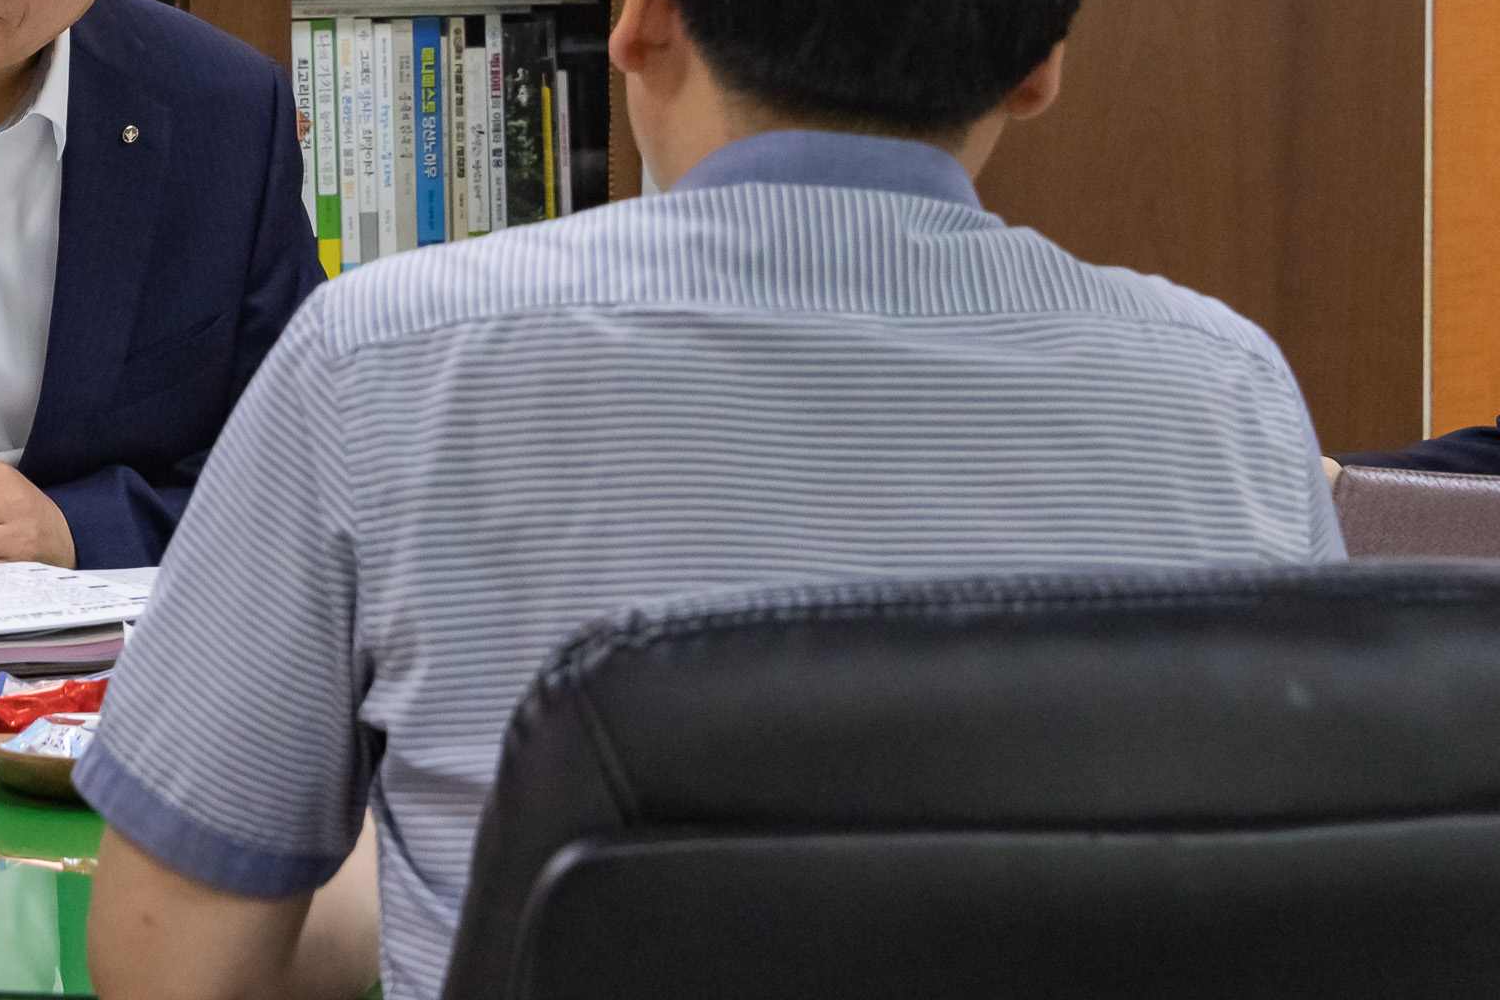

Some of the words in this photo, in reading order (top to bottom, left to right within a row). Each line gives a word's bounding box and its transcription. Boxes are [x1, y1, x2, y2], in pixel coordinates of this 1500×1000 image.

[421, 46, 437, 114] 매니페스토
[360, 127, 376, 178] 희망이다
[422, 115, 439, 179] 당선노하우
